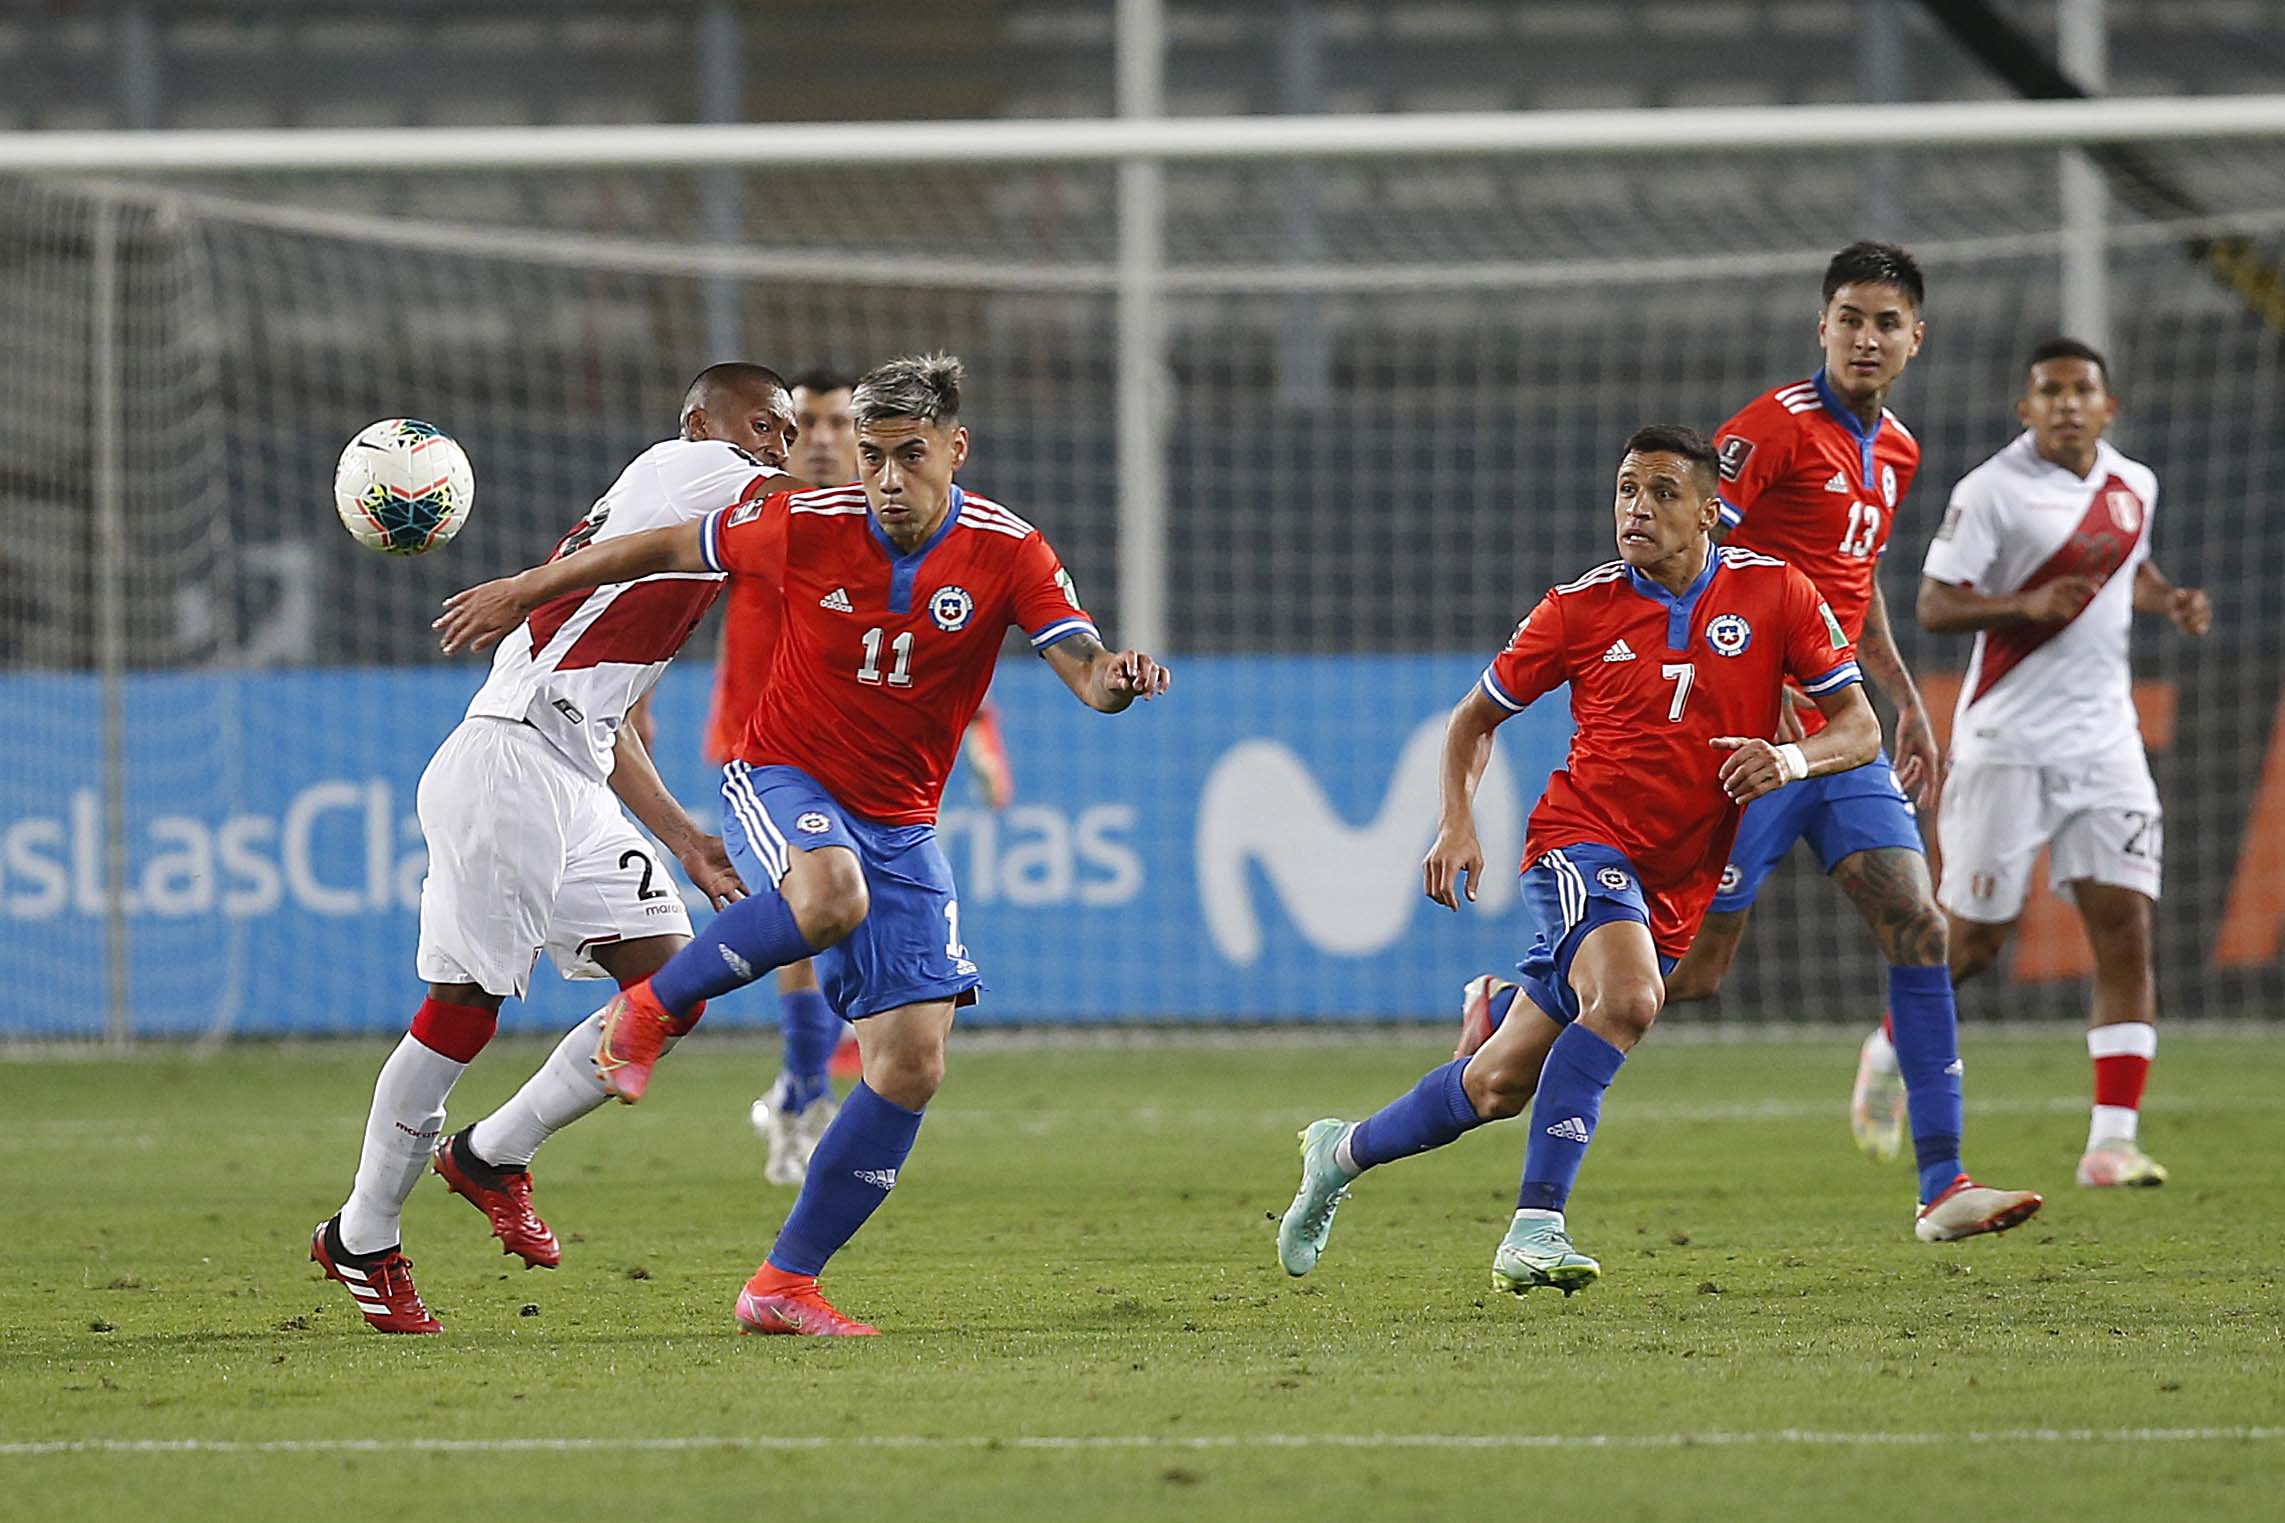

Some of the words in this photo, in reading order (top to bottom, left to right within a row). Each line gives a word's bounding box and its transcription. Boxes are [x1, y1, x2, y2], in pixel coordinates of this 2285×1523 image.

[1838, 500, 1880, 557] 13
[857, 627, 915, 688] 11
[1662, 663, 1696, 723] 7
[646, 904, 682, 916] mara
[1546, 1127, 1588, 1143] adidas
